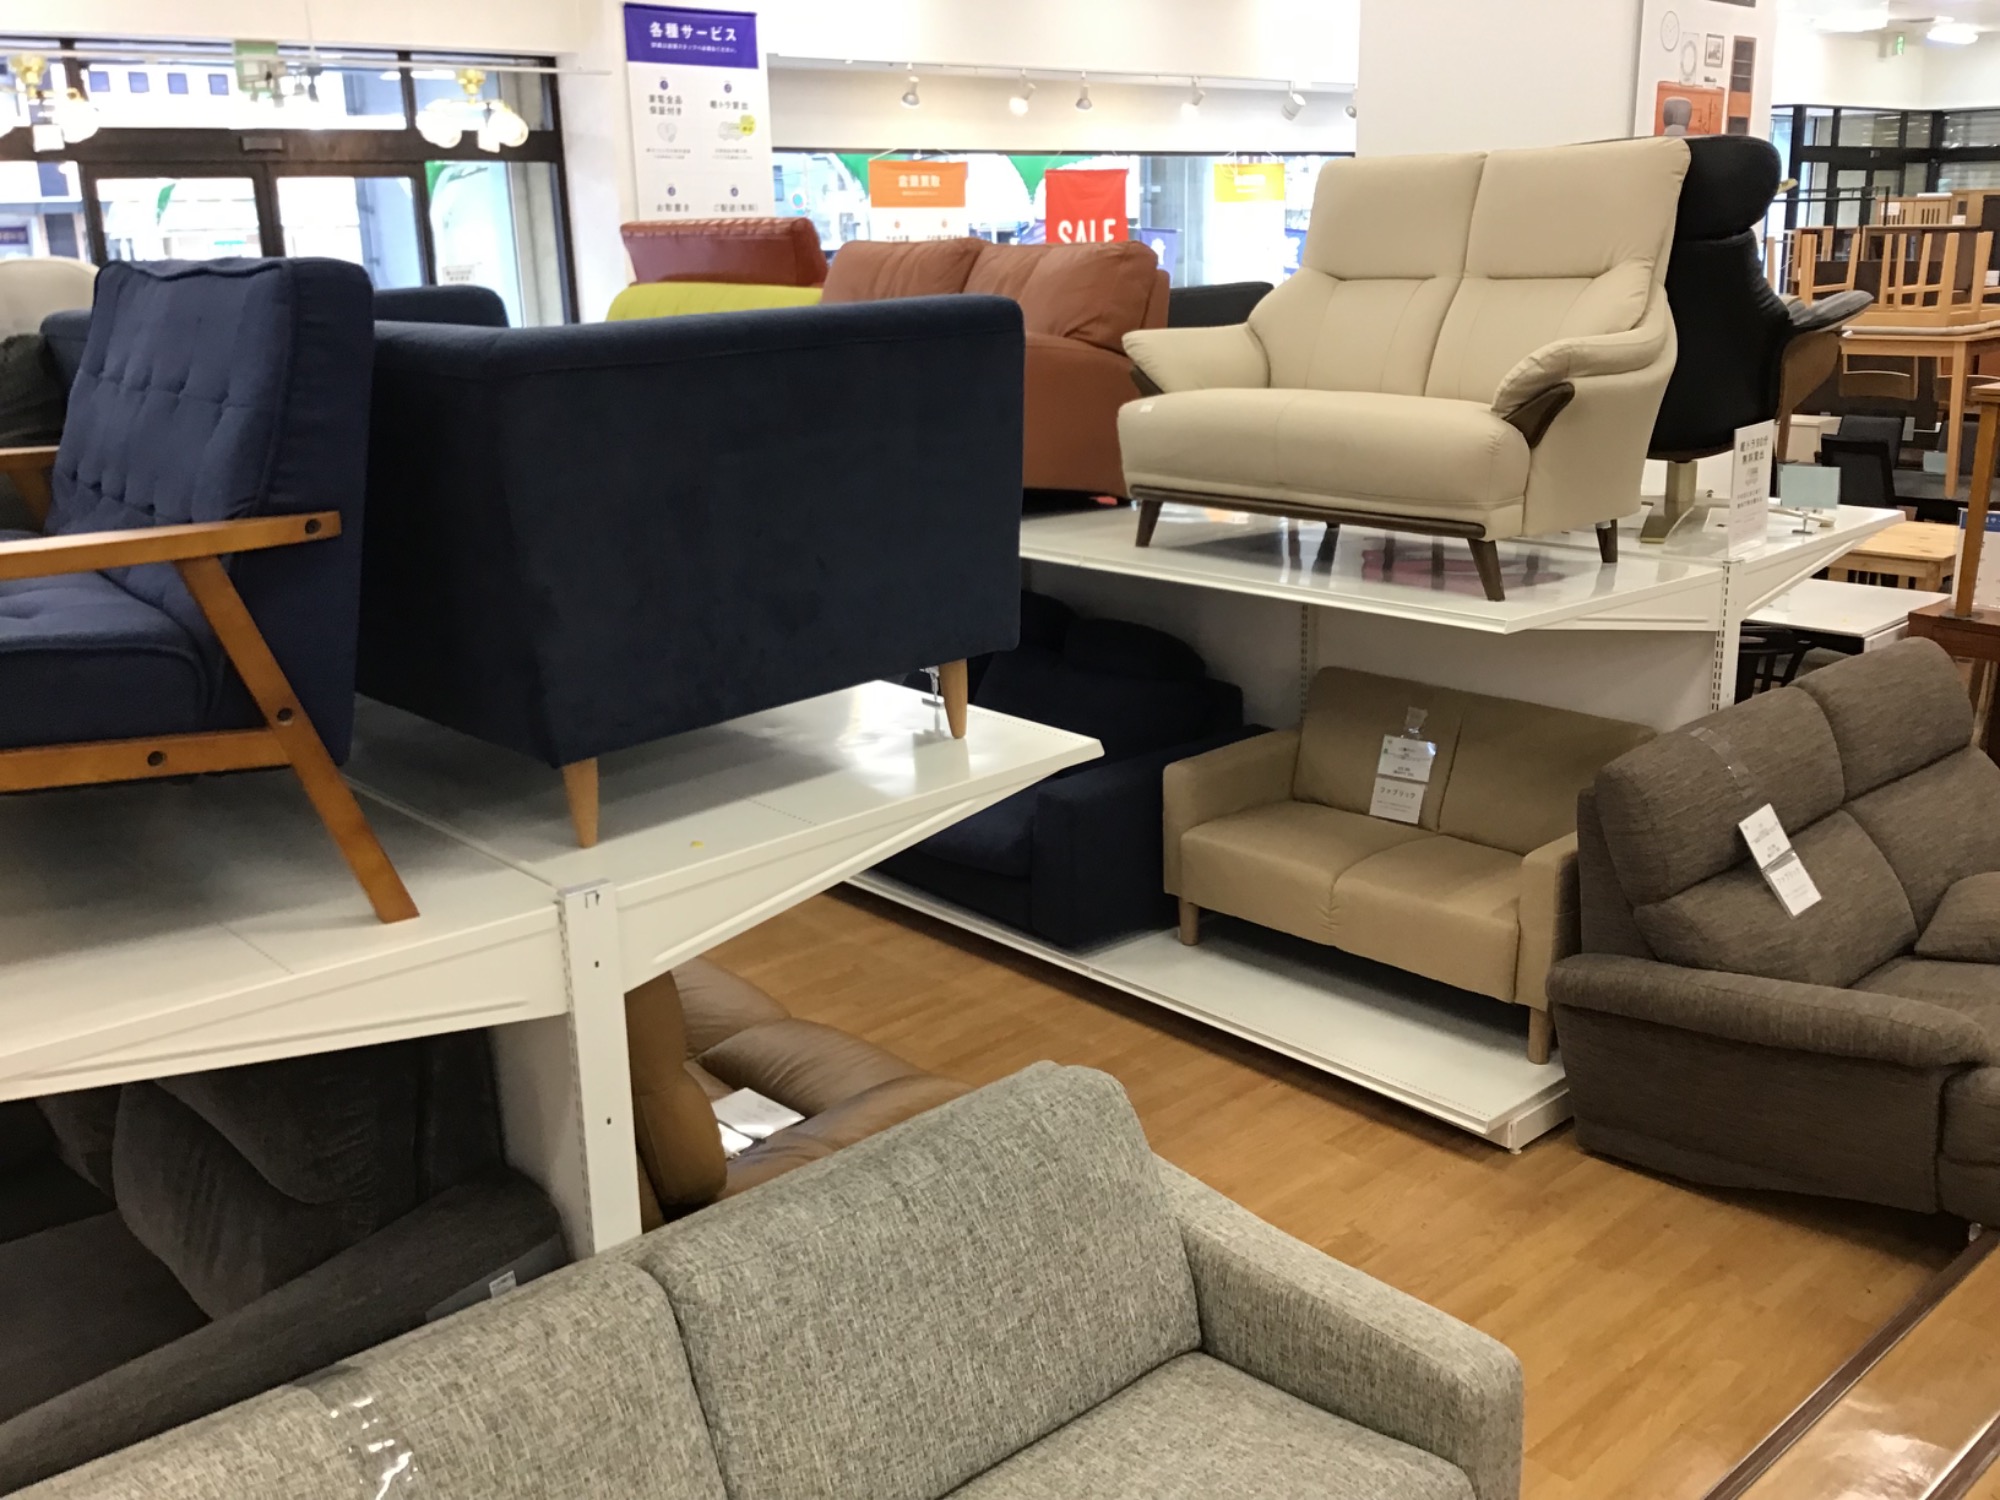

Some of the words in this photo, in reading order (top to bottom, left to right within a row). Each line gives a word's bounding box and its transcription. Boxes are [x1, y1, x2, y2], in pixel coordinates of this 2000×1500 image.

[649, 21, 737, 41] 各種サービス
